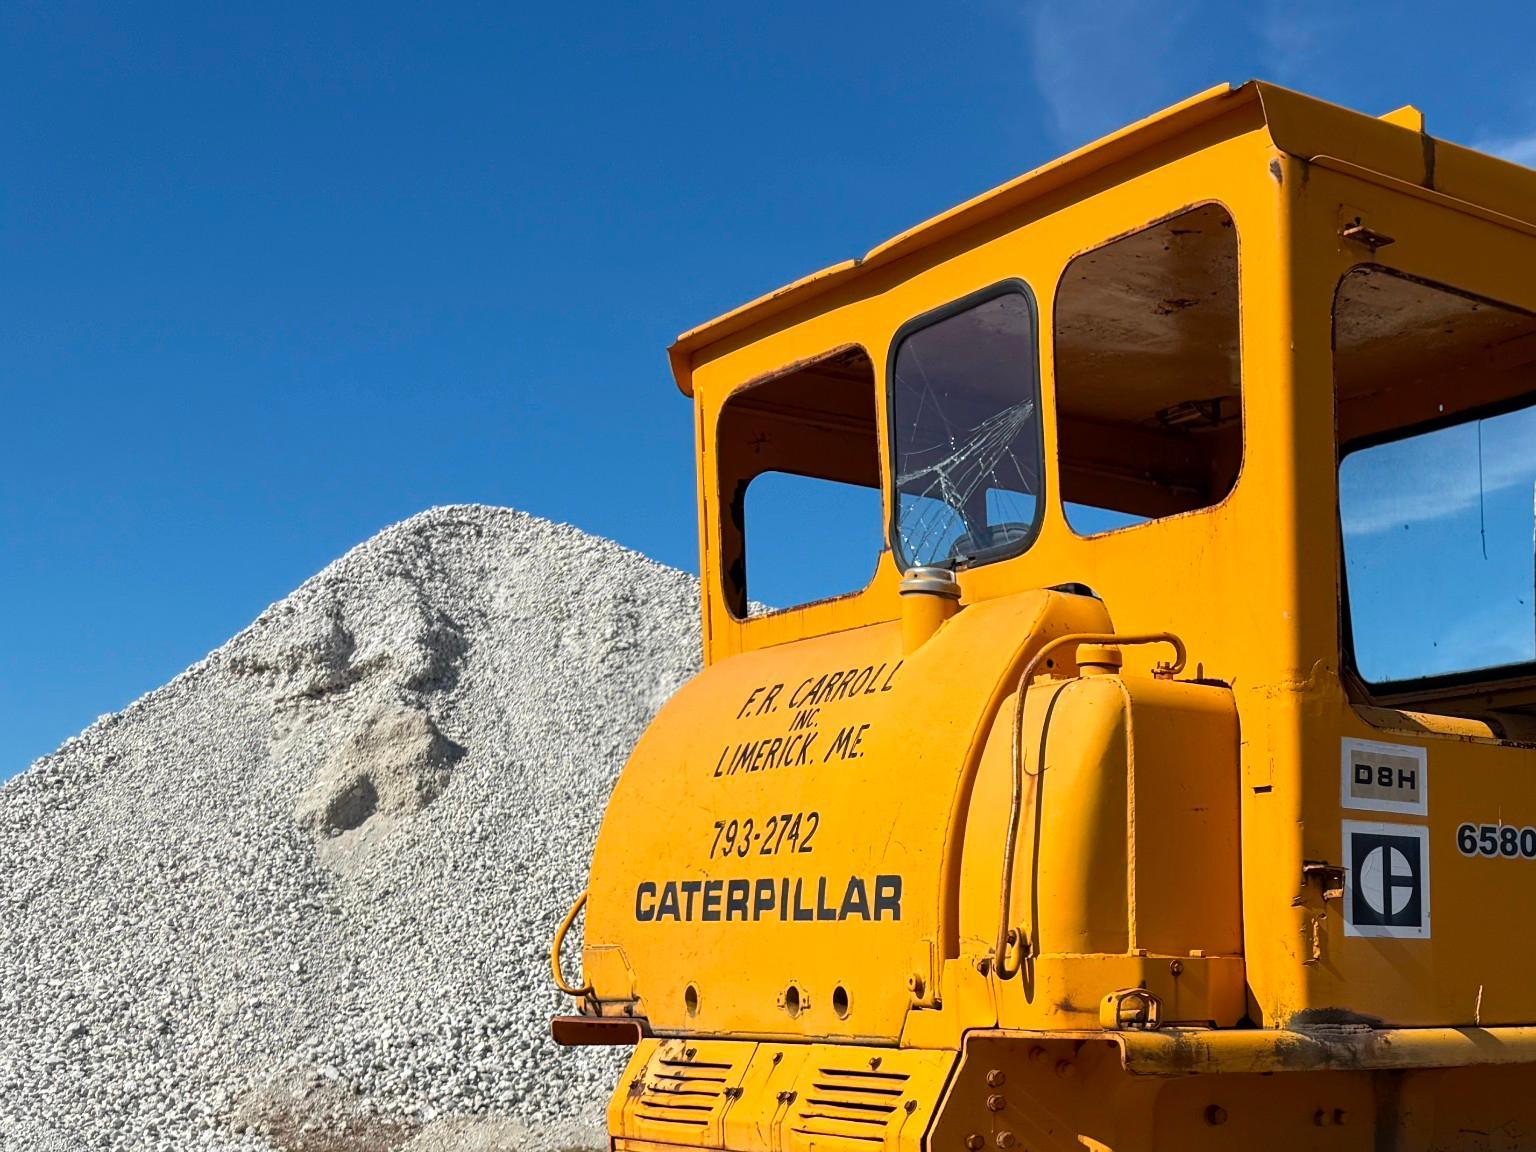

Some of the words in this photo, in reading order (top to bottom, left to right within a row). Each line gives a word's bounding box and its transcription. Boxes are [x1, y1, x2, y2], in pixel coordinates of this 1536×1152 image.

[788, 659, 905, 709] CARROLL
[788, 708, 820, 732] INC.
[823, 723, 871, 763] ME.
[1354, 763, 1416, 790] D8H
[709, 811, 820, 860] 793-2742
[635, 874, 903, 922] CATERPILLAR
